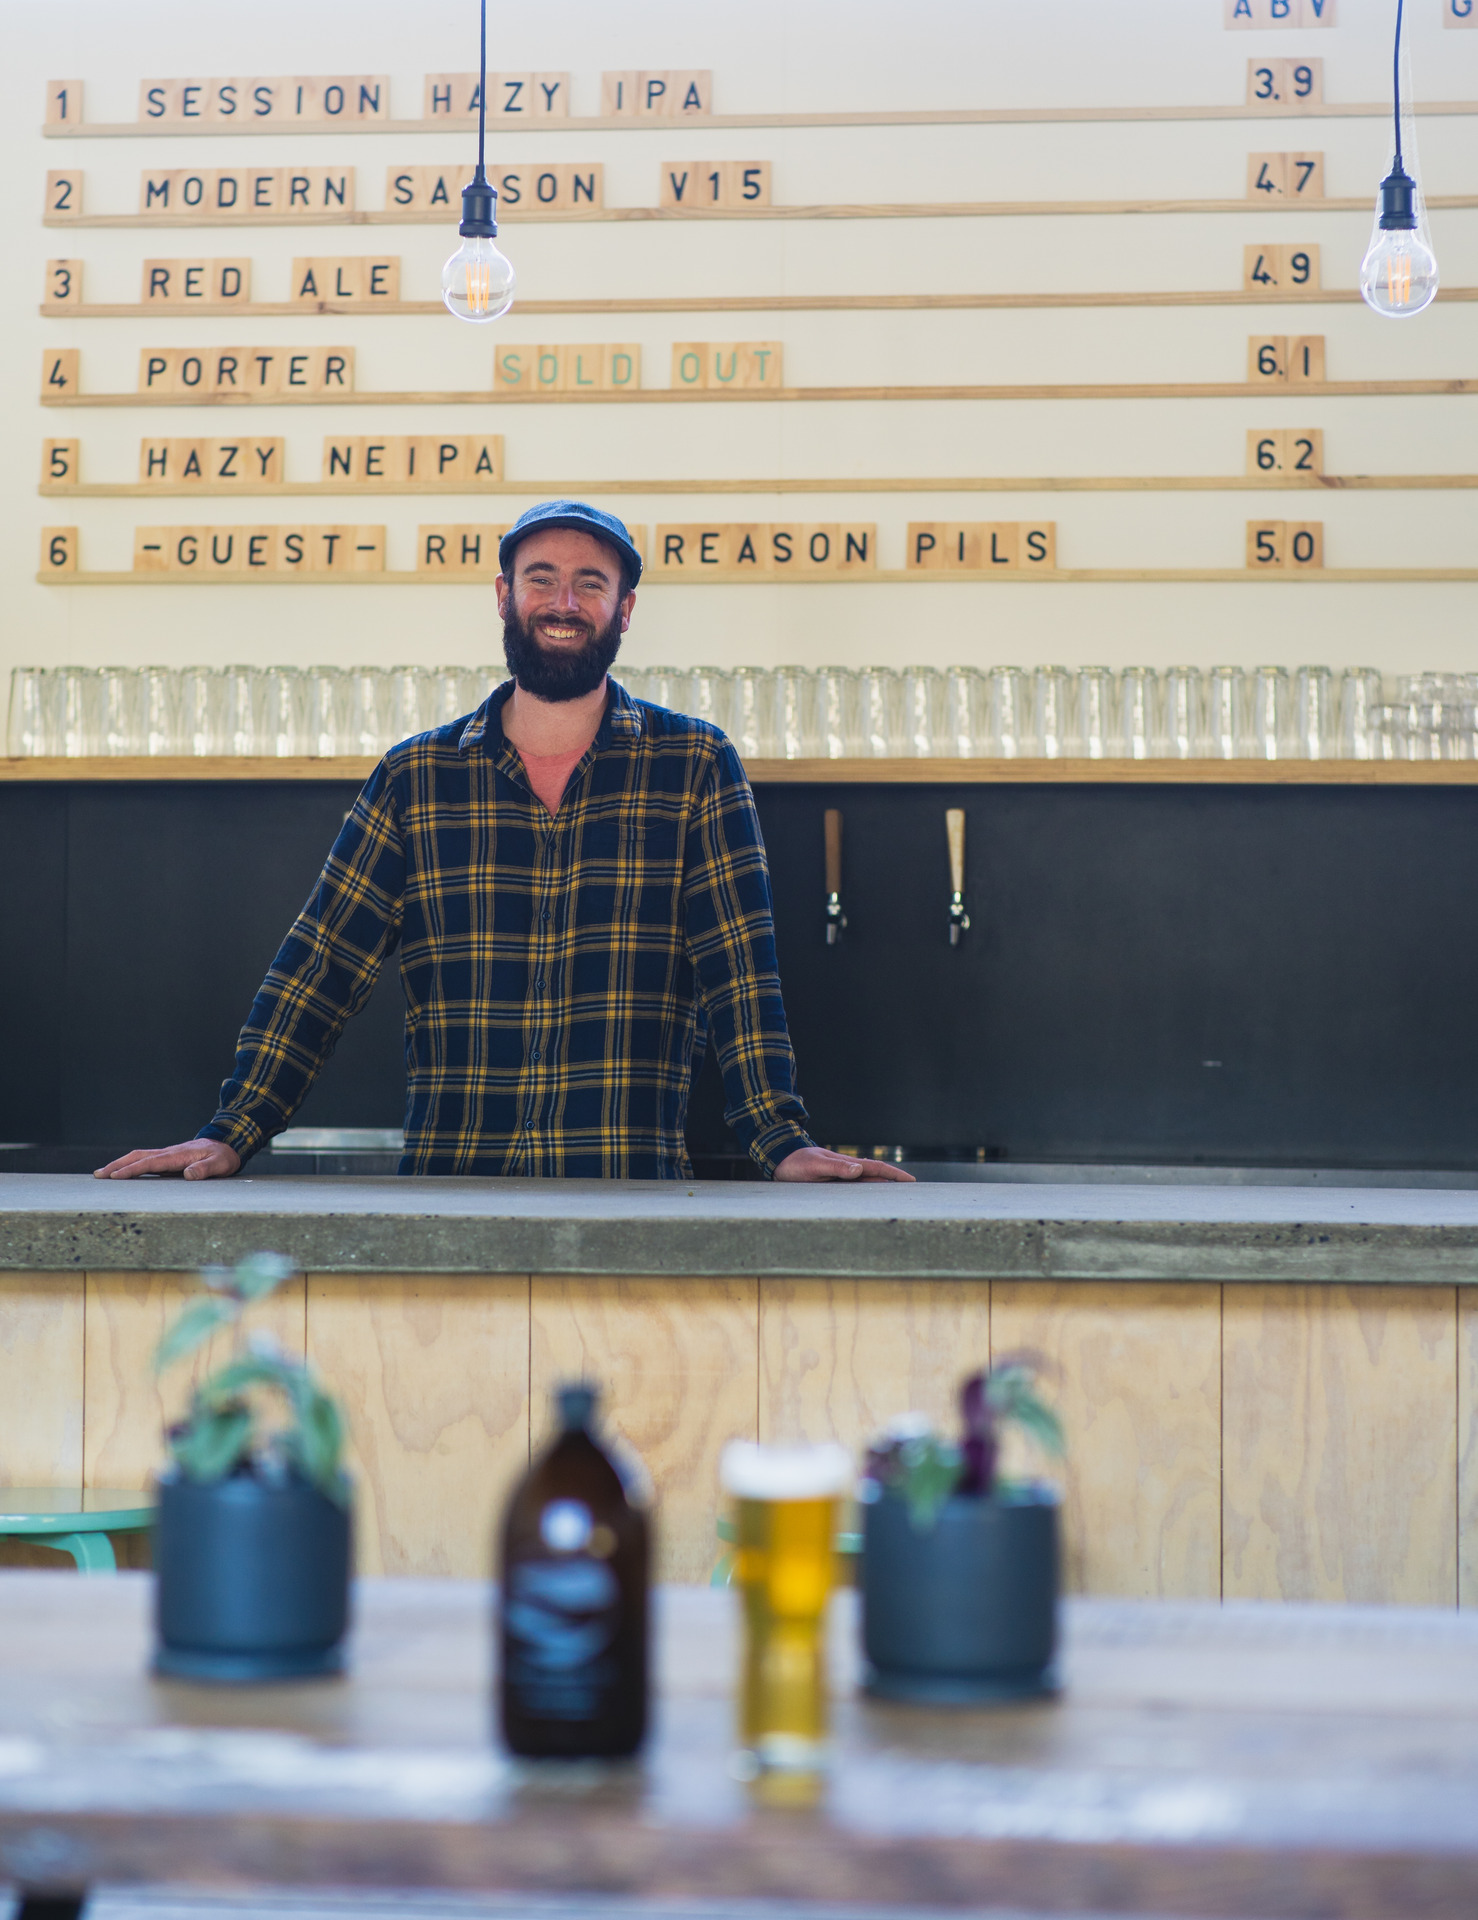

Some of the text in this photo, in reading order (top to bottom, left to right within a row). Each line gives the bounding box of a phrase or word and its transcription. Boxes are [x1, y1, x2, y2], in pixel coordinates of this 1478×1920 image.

[56, 66, 1312, 119] 1 SESSION HAZY IPA 3.9
[54, 162, 1315, 209] 2 MODERN SASON V15 4.7
[54, 253, 1310, 298] 3 RED ALE 4.9
[48, 345, 1309, 388] 4 PORTER SOLD OUT 6.1
[50, 439, 1314, 477] 5 HAZY NEIPA 6.2
[49, 530, 1314, 566] 6 -GUEST- REASON PILS 5.0
